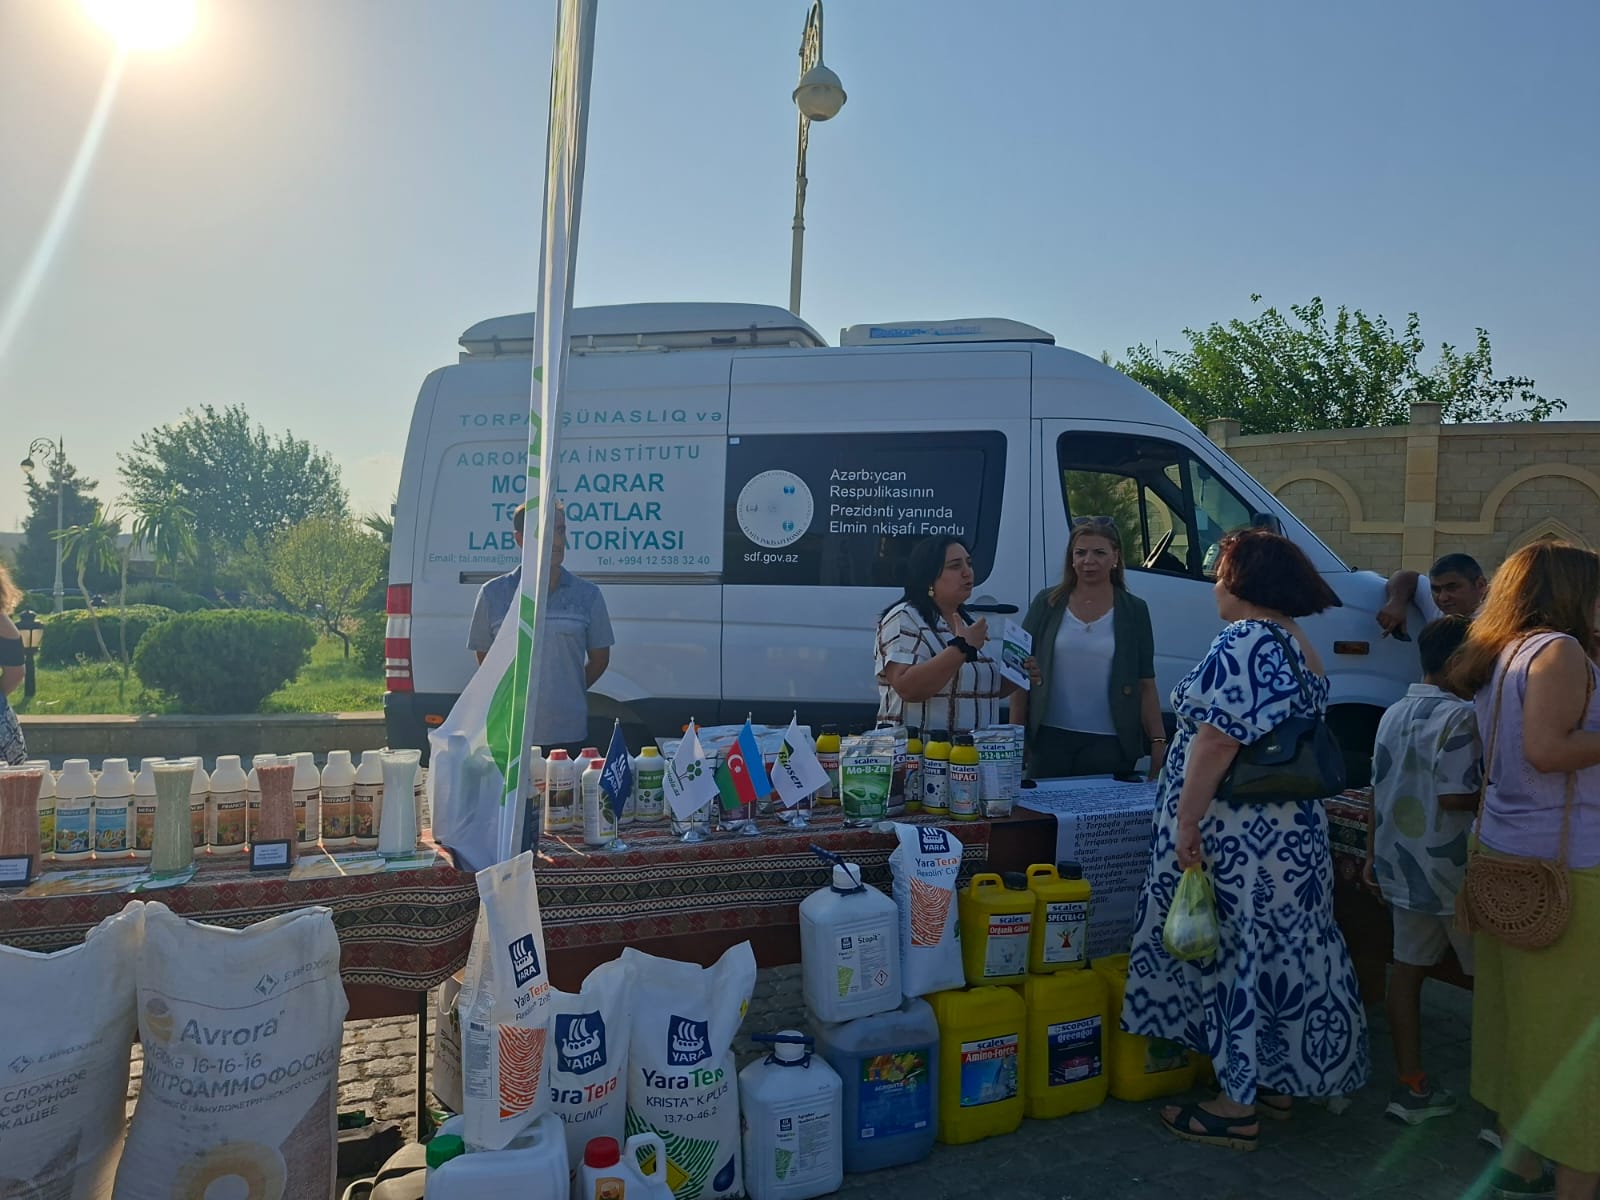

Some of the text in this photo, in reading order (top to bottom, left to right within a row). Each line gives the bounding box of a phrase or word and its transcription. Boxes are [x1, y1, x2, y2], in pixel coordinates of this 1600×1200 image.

[459, 409, 722, 428] TORPŞÜNASLIQ və
[457, 444, 701, 467] AQROKYA İNSTİTUTU
[492, 473, 665, 494] MOL AQRAR
[492, 500, 662, 521] TƏQATLAR
[897, 507, 953, 521] yanında
[469, 526, 684, 550] LABTORİYASI
[830, 521, 964, 537] Elmin nkişafı Fondu
[618, 555, 642, 565] +994
[646, 555, 657, 565] 12
[661, 555, 679, 565] 538
[683, 555, 694, 565] 32
[698, 555, 710, 565] 40
[744, 551, 799, 564] sdf.gov.az
[854, 757, 878, 765] scalex
[180, 1017, 279, 1047] Avrora
[193, 1052, 262, 1073] 16-16-16
[564, 1052, 603, 1071] YARA
[672, 1050, 706, 1063] YARA
[551, 1075, 618, 1105] araTera
